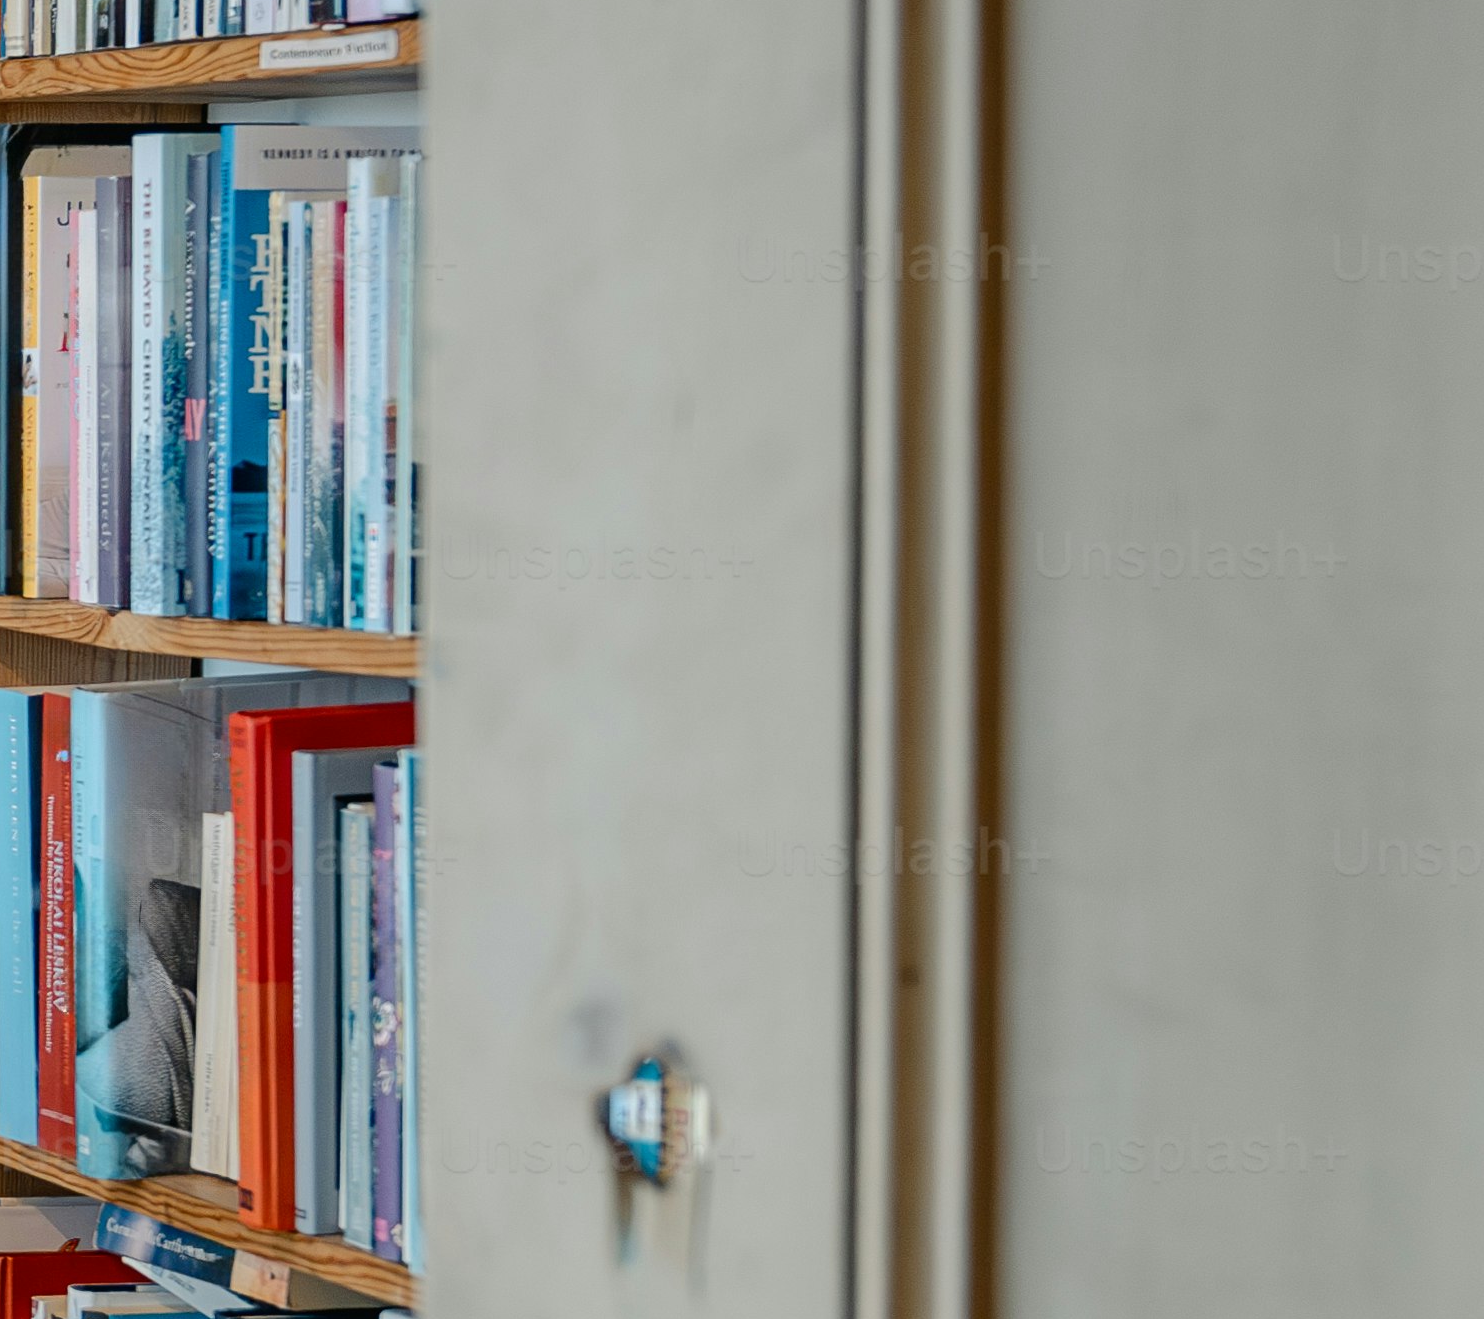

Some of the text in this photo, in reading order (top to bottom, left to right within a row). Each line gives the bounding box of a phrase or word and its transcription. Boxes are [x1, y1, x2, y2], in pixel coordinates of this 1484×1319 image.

[143, 178, 153, 221] THE
[143, 228, 153, 327] BETRAYED
[142, 339, 151, 427] CHRISTY
[218, 300, 229, 397] BENEATH
[217, 401, 228, 445] THE
[99, 441, 112, 552] Kennedy
[206, 441, 218, 558] Kennedy
[217, 453, 227, 511] NEON
[53, 840, 65, 928] NIKOLAI
